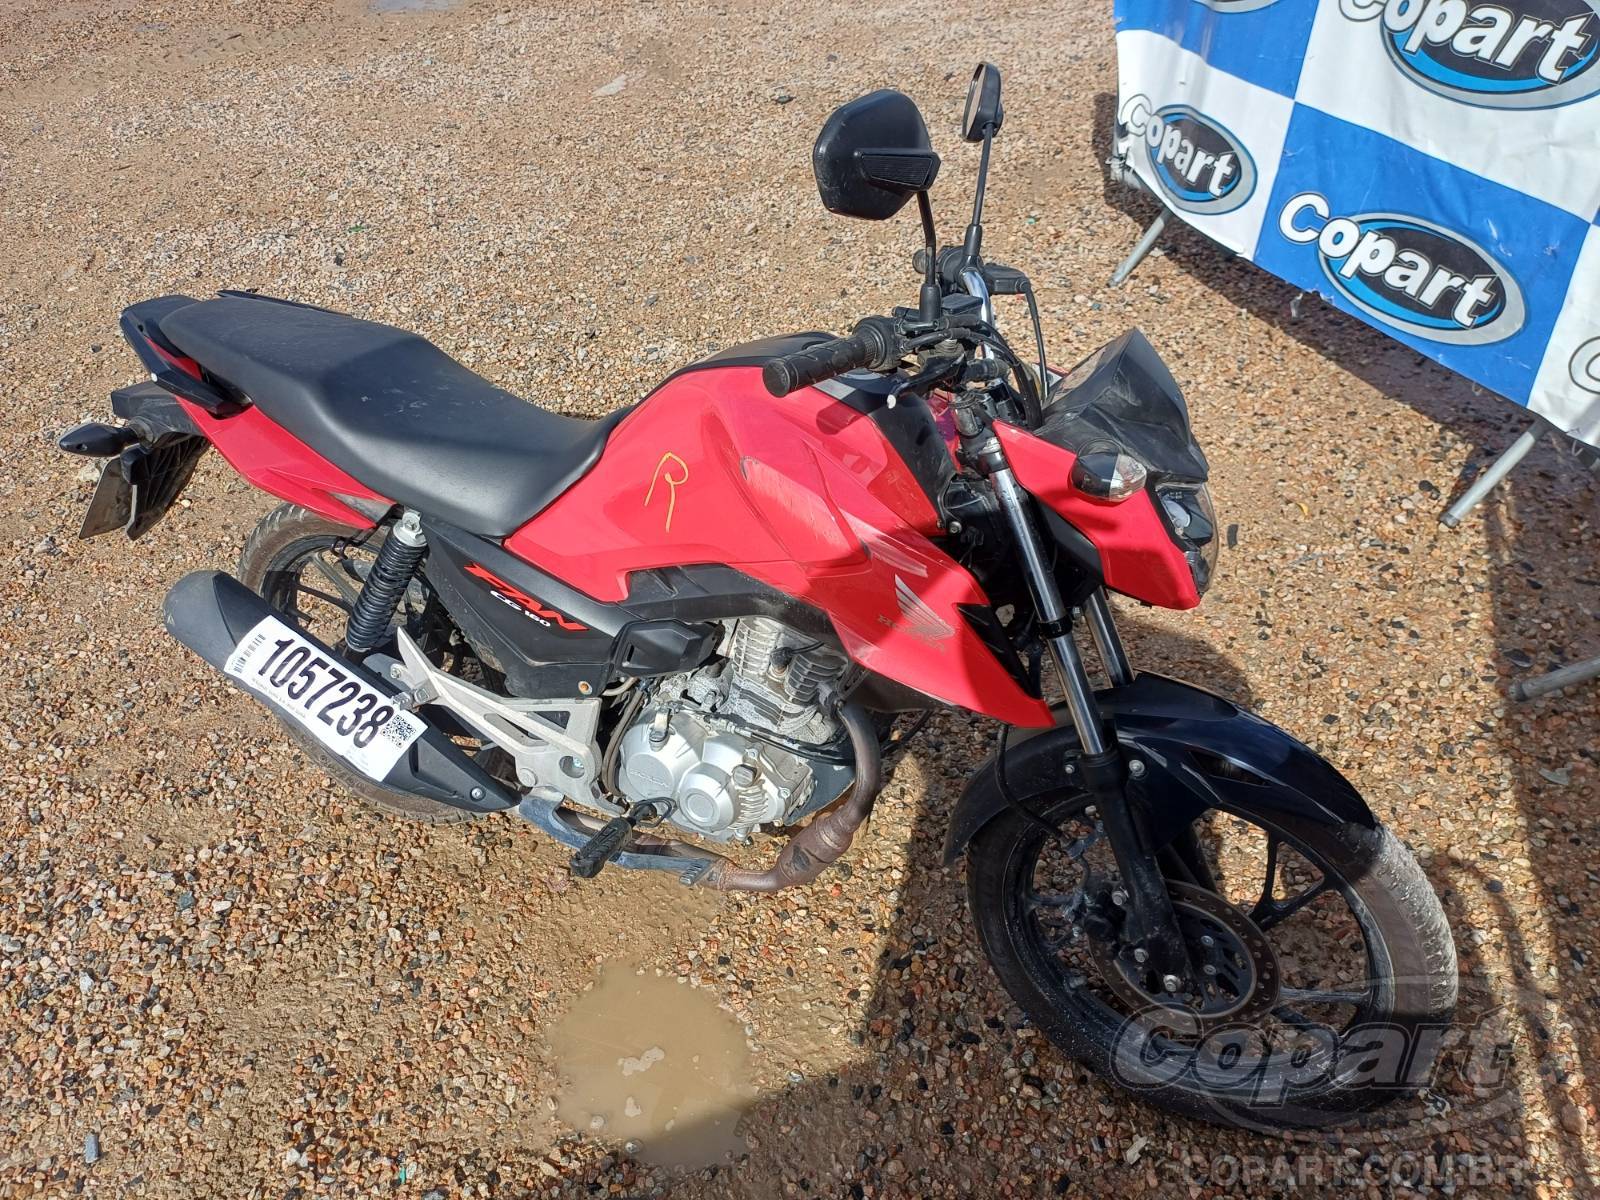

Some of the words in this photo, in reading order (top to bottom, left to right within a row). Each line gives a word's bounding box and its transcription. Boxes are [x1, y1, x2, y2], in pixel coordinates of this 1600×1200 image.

[1121, 93, 1238, 198] Copart
[1279, 193, 1500, 328] Copart
[490, 590, 522, 611] CG
[524, 609, 551, 627] 160
[258, 638, 394, 748] 1057238
